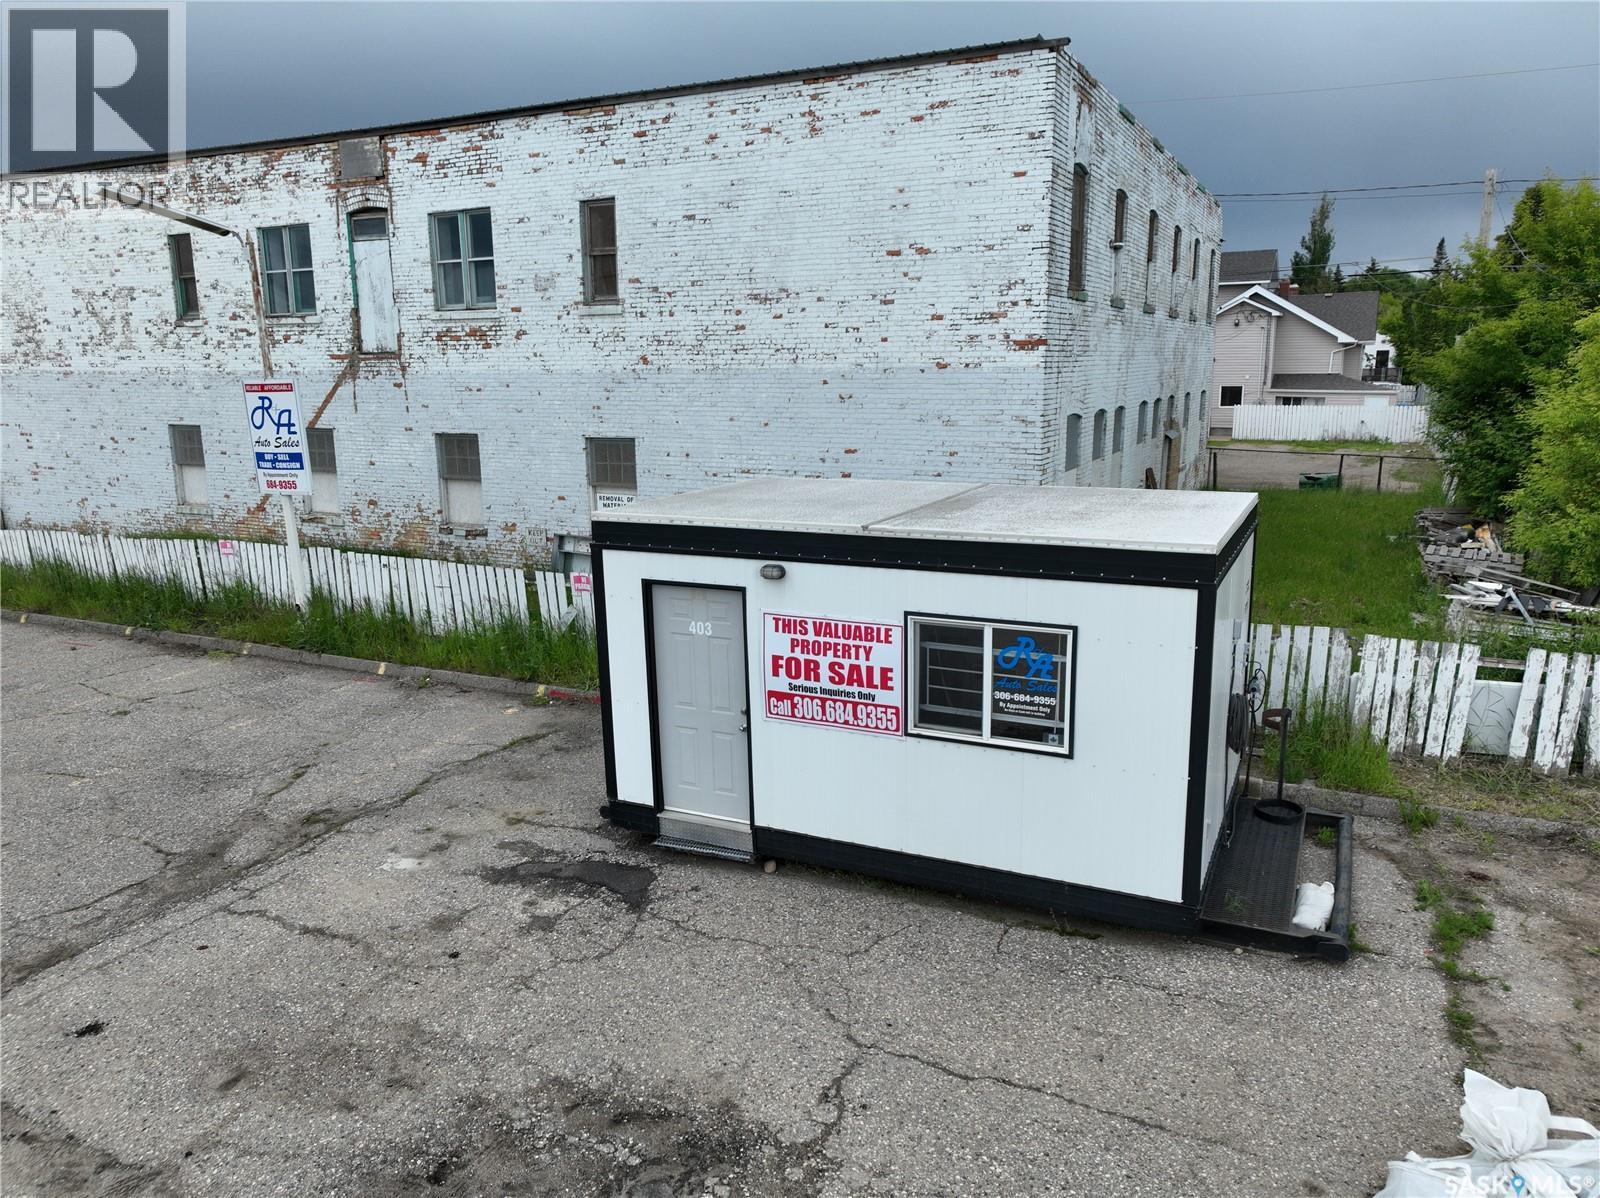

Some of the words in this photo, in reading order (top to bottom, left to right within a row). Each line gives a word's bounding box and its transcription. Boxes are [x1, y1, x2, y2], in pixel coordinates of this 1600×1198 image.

[254, 436, 271, 448] Auto
[274, 436, 300, 449] Sales
[277, 453, 290, 461] SELL
[266, 479, 298, 490] 684-9355
[598, 495, 624, 503] REMOVAL
[688, 620, 713, 636] 403
[772, 616, 809, 637] THIS
[812, 620, 893, 644] VALUABLE
[790, 637, 874, 662] PROPERTY
[771, 654, 821, 683] FOR
[828, 660, 895, 691] SALE
[788, 682, 819, 695] Serious
[819, 685, 856, 700] Inquiries
[857, 691, 876, 702] Only
[994, 690, 1056, 706] 306-684-9355
[769, 697, 792, 716] Call
[793, 697, 898, 731] 306.684.9355
